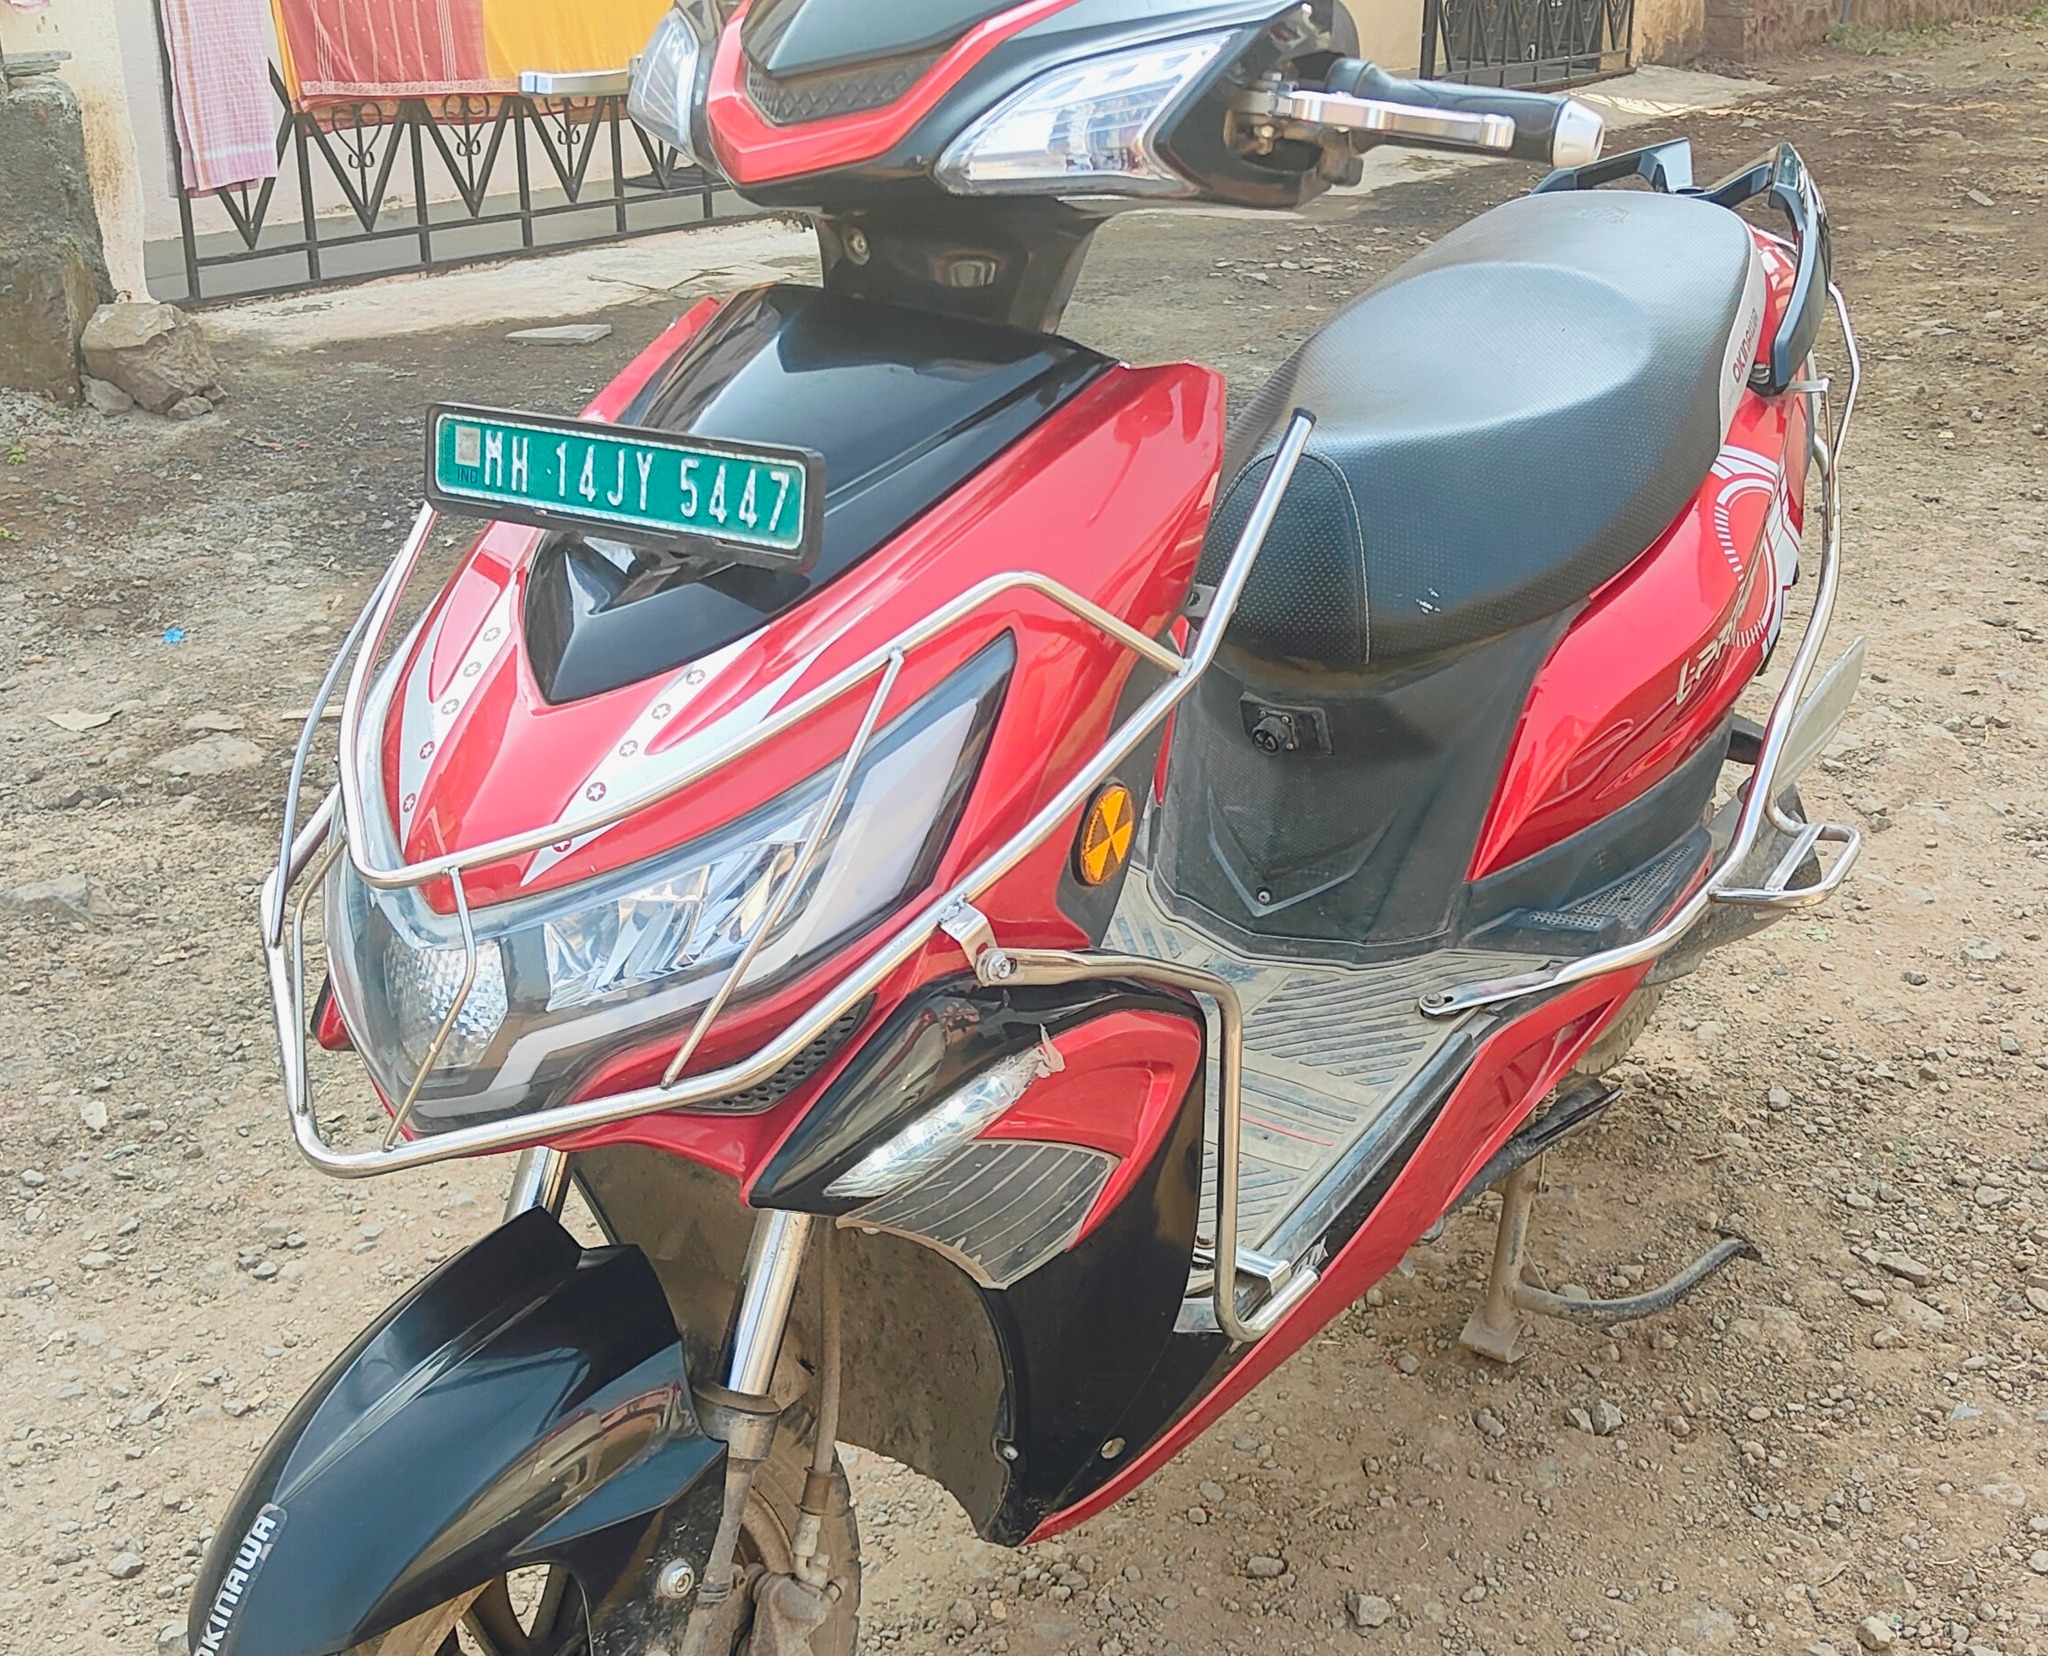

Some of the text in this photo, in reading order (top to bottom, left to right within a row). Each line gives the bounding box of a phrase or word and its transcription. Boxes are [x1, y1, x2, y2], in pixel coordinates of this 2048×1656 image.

[457, 466, 478, 483] IND
[484, 429, 529, 493] MH
[680, 458, 790, 532] 5447
